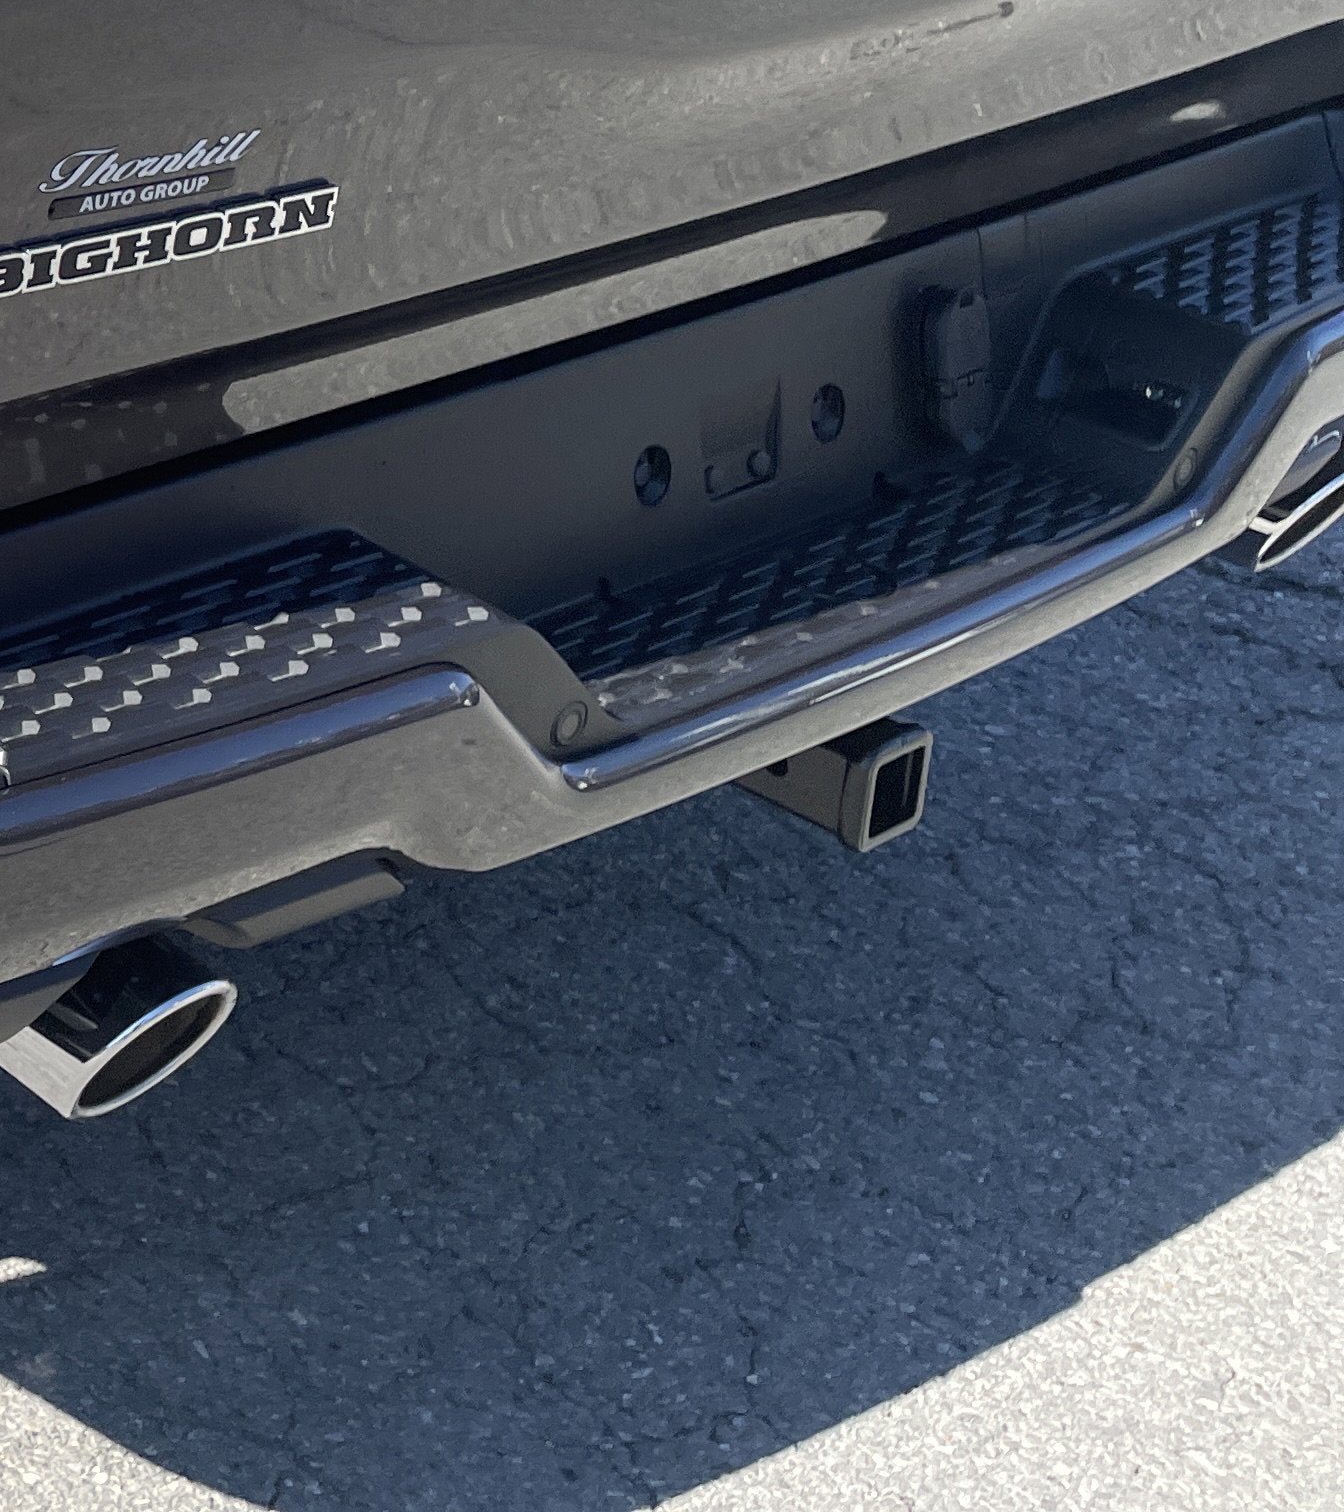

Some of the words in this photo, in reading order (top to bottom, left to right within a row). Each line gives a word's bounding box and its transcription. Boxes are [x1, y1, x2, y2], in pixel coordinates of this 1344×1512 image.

[39, 128, 261, 194] Thornhill
[79, 189, 136, 215] AUTO
[139, 175, 210, 204] GROUP
